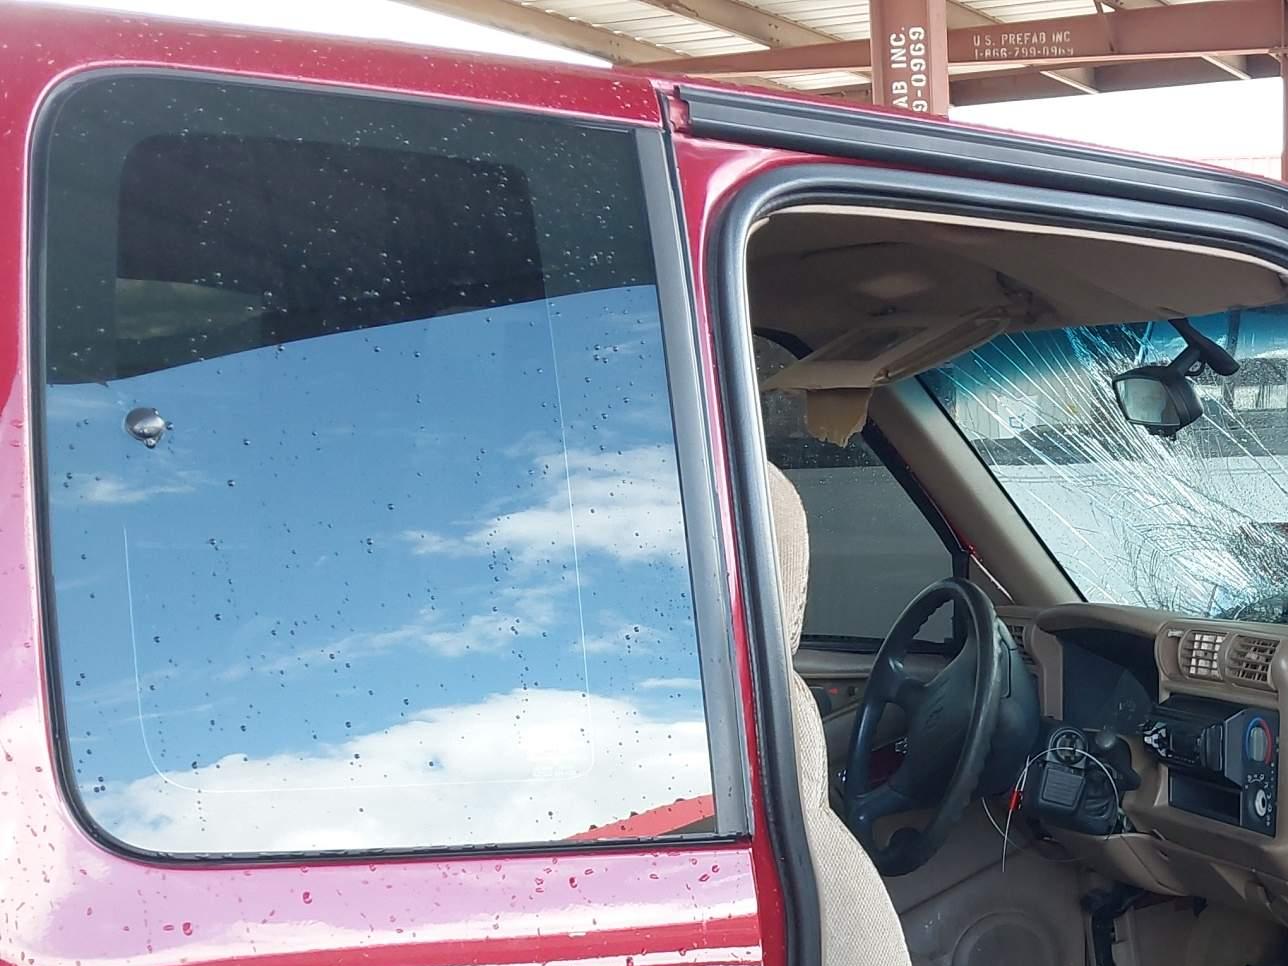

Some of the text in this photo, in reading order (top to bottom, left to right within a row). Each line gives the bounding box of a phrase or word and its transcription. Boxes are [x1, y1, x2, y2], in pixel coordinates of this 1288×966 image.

[889, 26, 907, 69] INC.
[1001, 31, 1046, 46] PREFAB
[1052, 30, 1071, 43] INC
